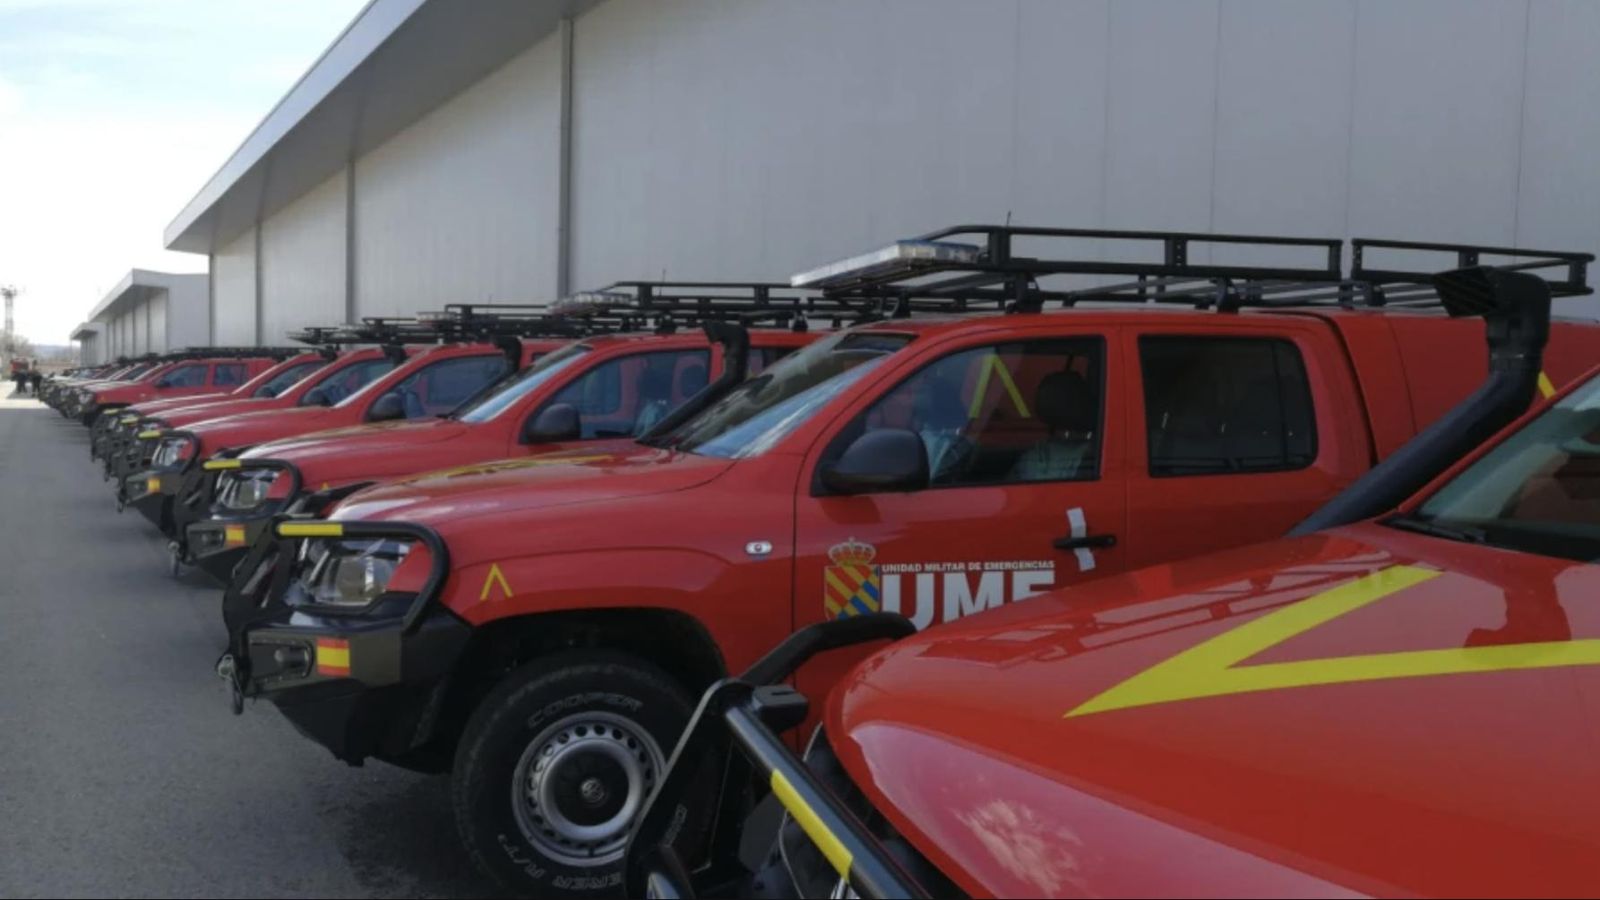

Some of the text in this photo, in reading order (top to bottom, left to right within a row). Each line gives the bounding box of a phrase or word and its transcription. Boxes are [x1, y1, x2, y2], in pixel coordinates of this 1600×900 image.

[882, 560, 1056, 573] UNIDAD MILITAR DE EMERGENCIAS
